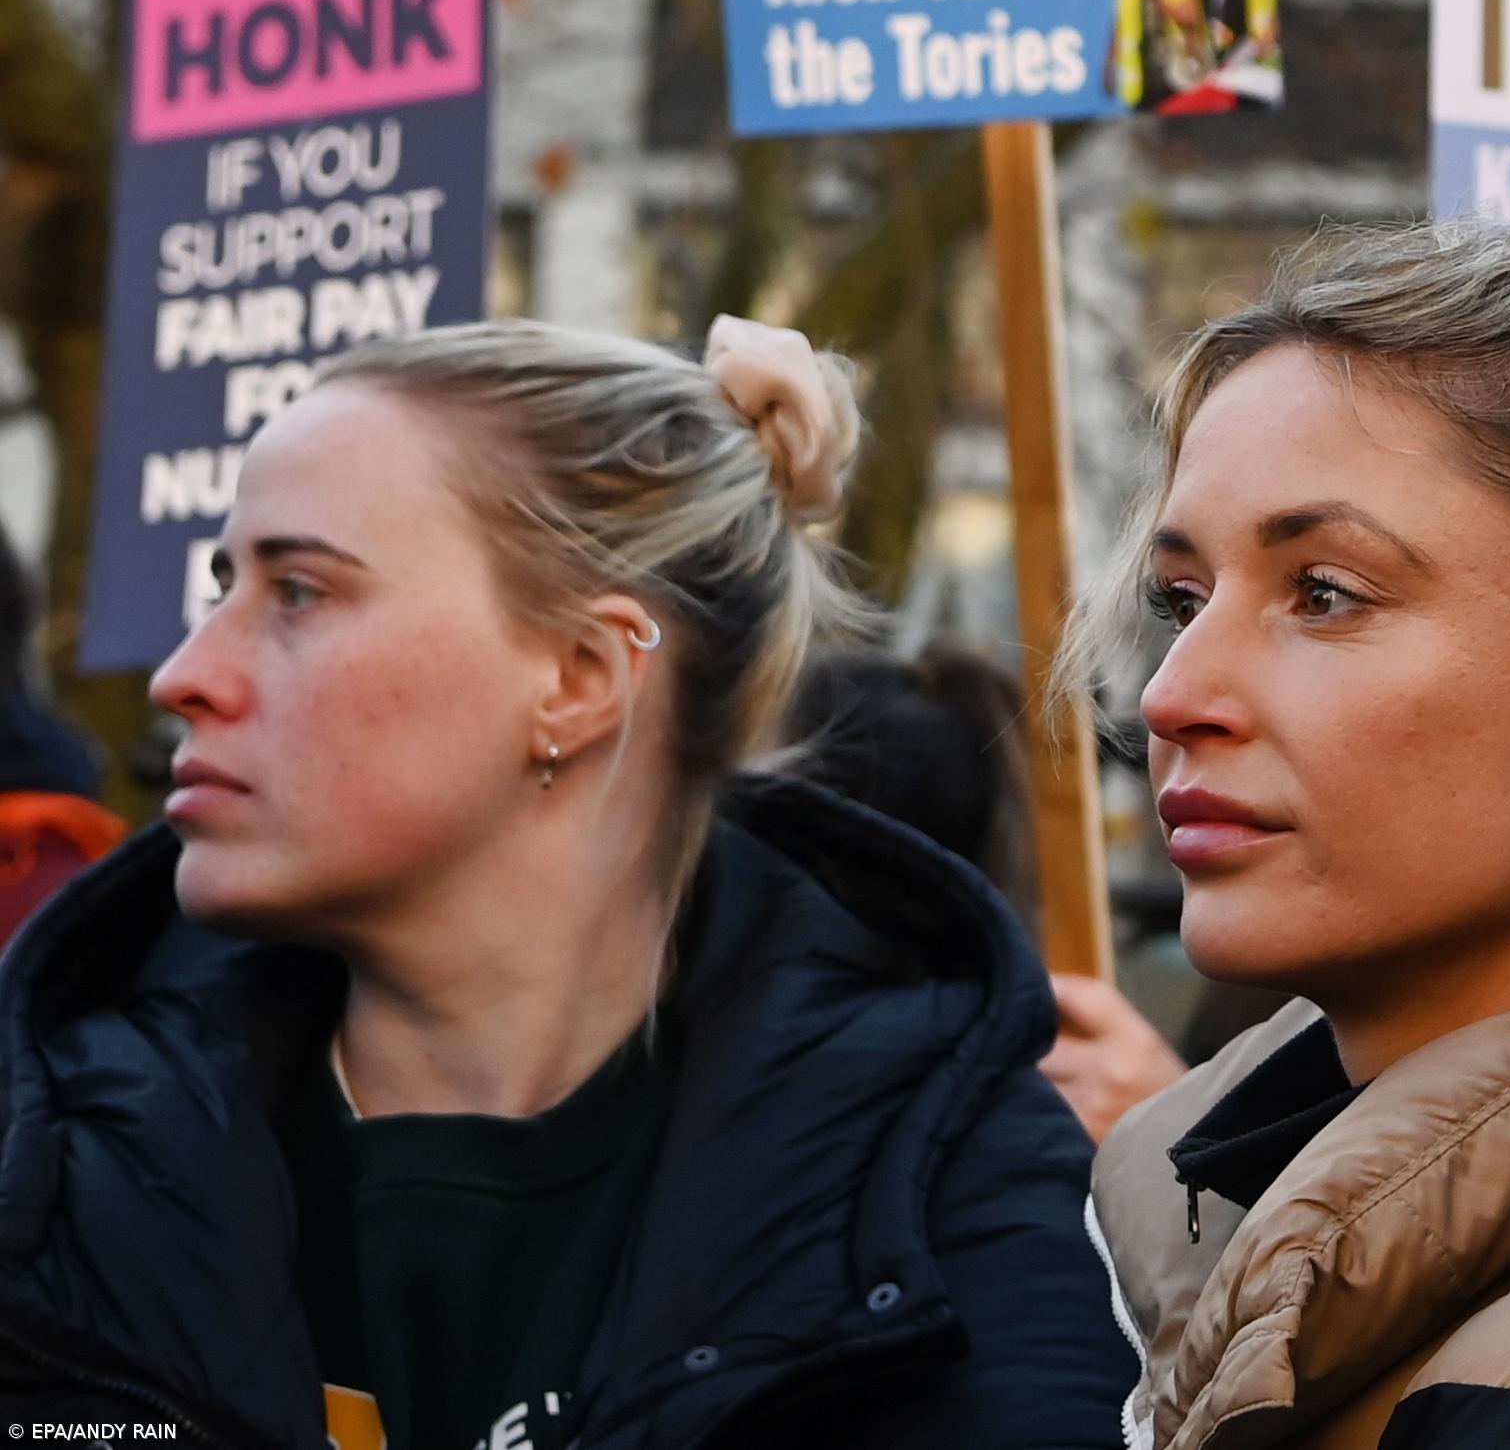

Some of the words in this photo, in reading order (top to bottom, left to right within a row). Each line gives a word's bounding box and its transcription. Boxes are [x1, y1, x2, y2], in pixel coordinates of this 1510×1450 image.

[765, 23, 875, 109] the
[887, 10, 1087, 101] Tories
[207, 138, 261, 211] IF
[271, 118, 402, 200] YOU
[158, 186, 444, 294] SUPPORT
[154, 288, 304, 370] FAIR
[311, 264, 441, 350] PAY
